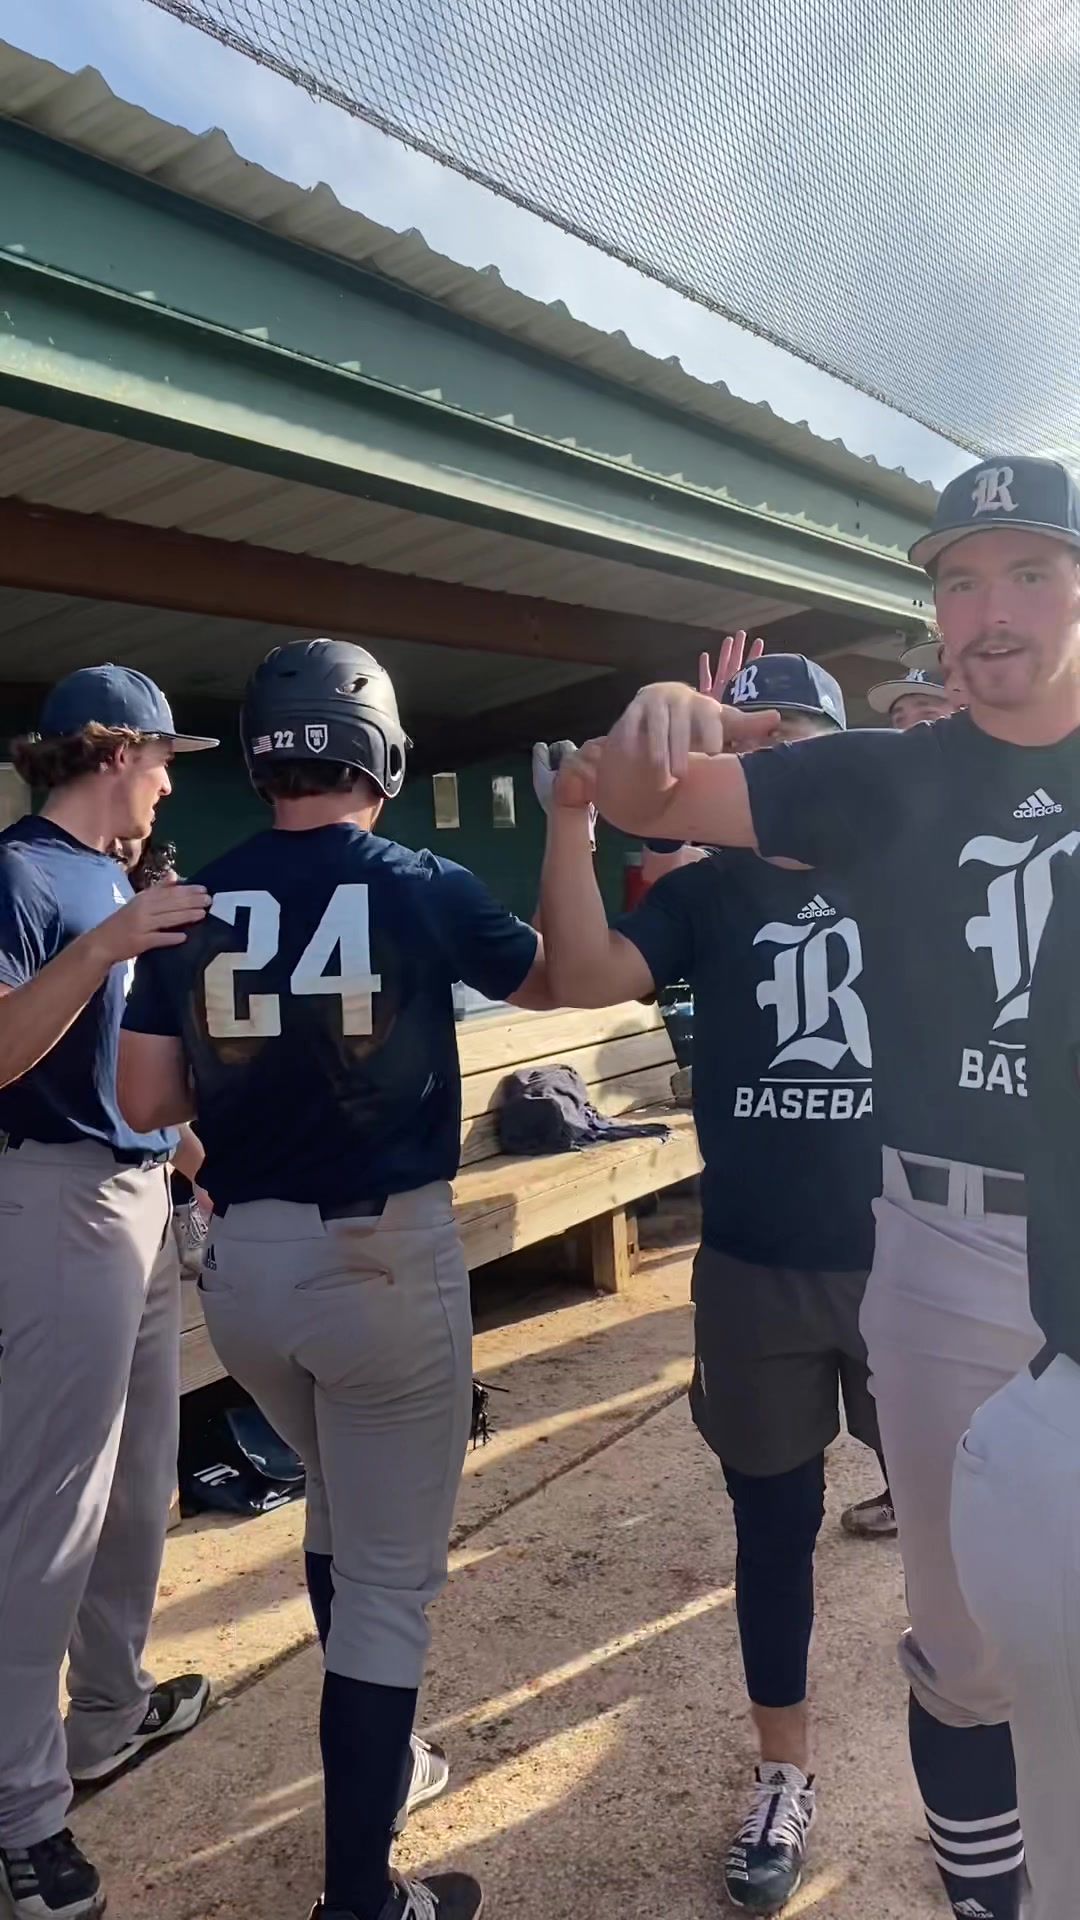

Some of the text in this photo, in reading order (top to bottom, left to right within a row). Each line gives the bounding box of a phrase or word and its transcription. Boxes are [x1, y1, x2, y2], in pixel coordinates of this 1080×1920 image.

[971, 466, 1019, 517] R
[733, 665, 760, 704] R
[274, 730, 294, 748] 22
[1013, 804, 1063, 818] adidas
[797, 907, 836, 919] adidas
[204, 883, 382, 1037] 24
[753, 917, 872, 1070] R
